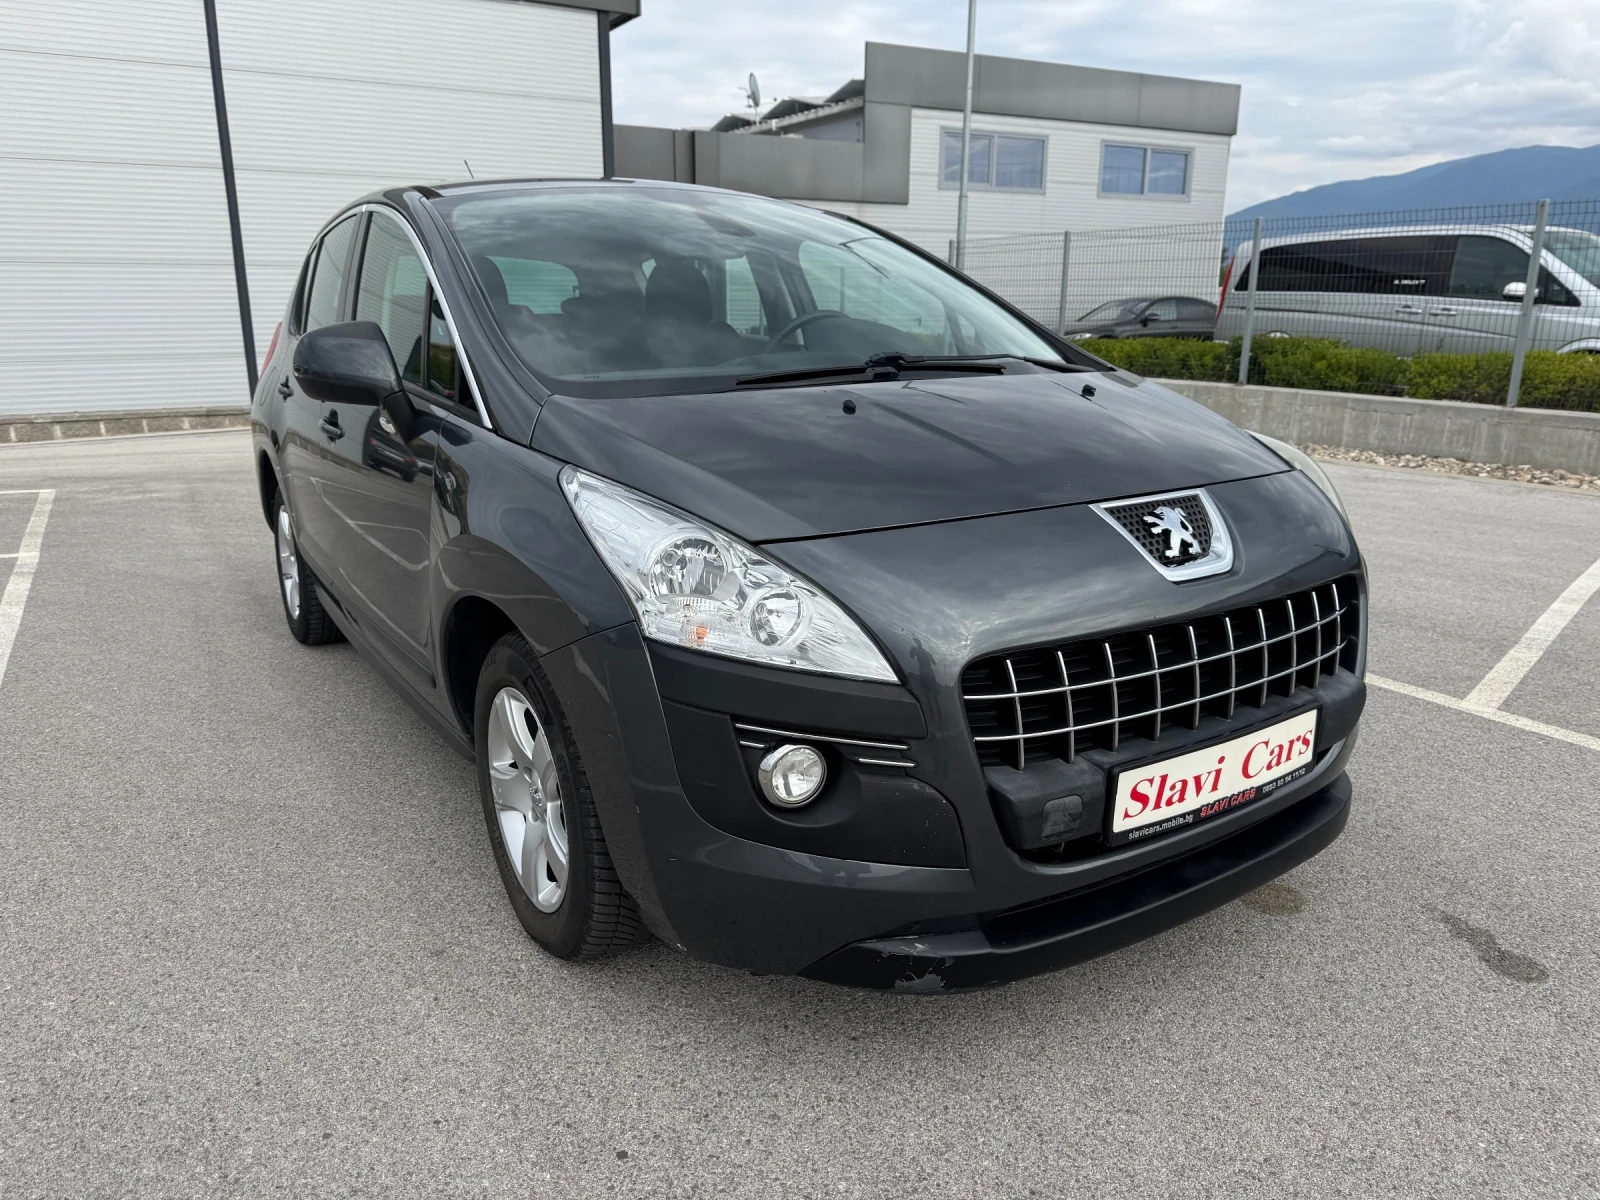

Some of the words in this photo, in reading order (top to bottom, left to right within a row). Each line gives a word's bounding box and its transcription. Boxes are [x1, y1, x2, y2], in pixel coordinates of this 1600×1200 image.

[1122, 755, 1226, 821] Slavi
[1241, 728, 1313, 780] Cars
[1128, 813, 1194, 840] slavicars.mobile.bg
[1200, 798, 1229, 818] SLAVI
[1230, 788, 1257, 807] CARS
